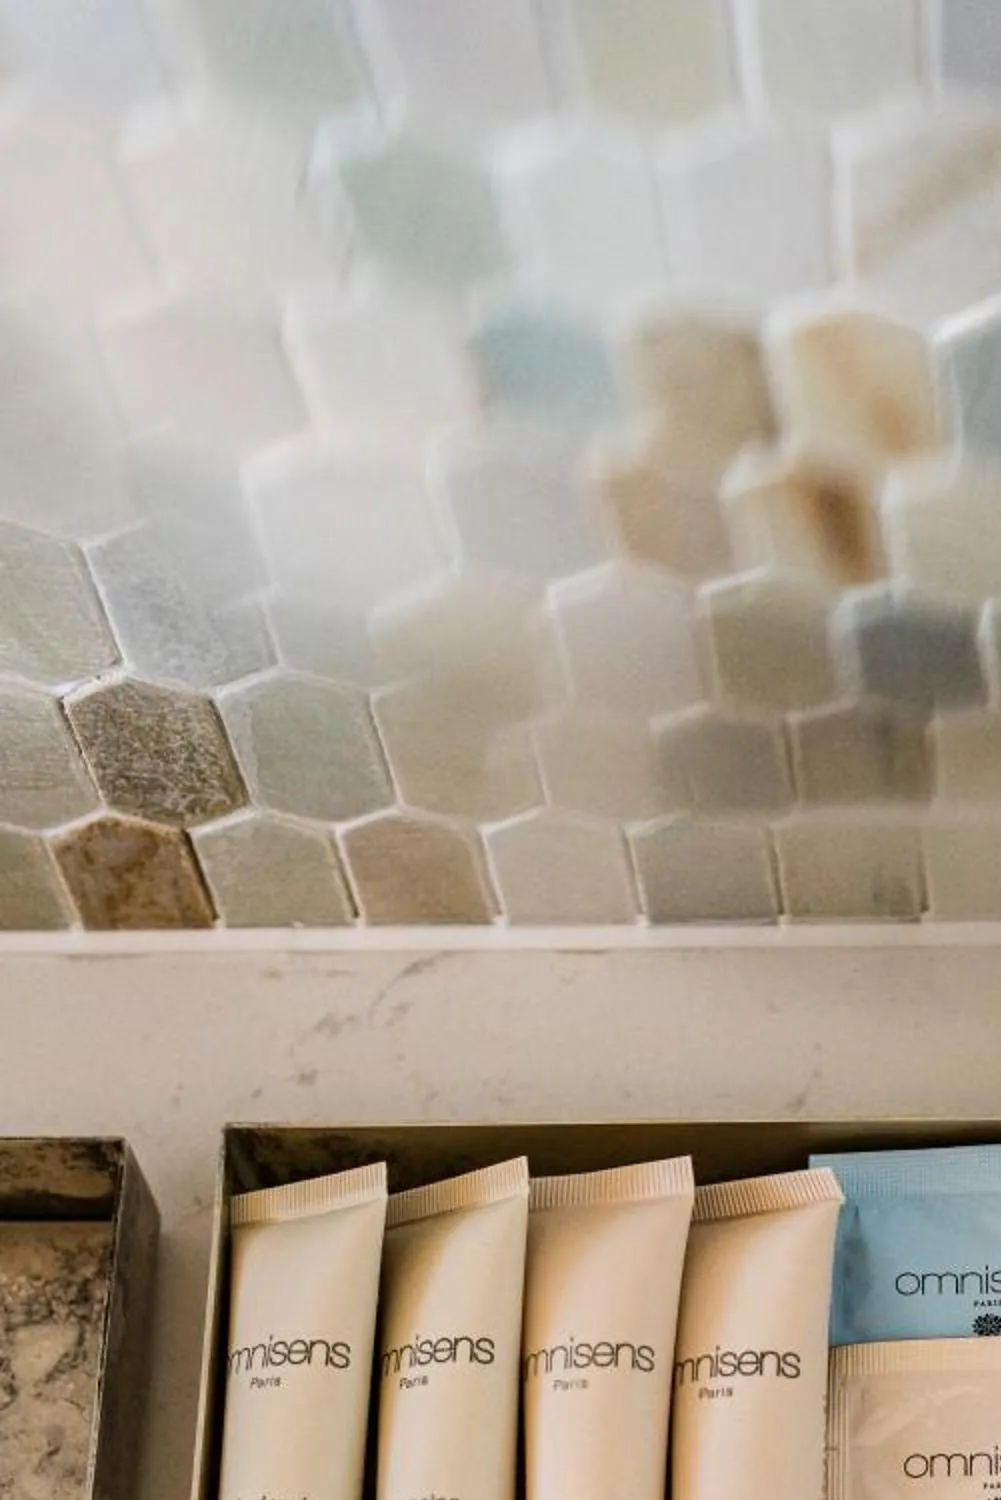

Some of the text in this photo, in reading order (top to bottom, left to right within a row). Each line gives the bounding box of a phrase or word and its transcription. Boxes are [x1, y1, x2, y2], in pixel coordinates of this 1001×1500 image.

[228, 1334, 351, 1377] mnisens
[383, 1334, 495, 1376] mnisens
[525, 1336, 655, 1380] mnisens
[675, 1345, 801, 1386] mnisens
[250, 1376, 282, 1389] Paris
[400, 1376, 428, 1390] Paris
[553, 1379, 589, 1392] Paris
[698, 1387, 734, 1399] Paris
